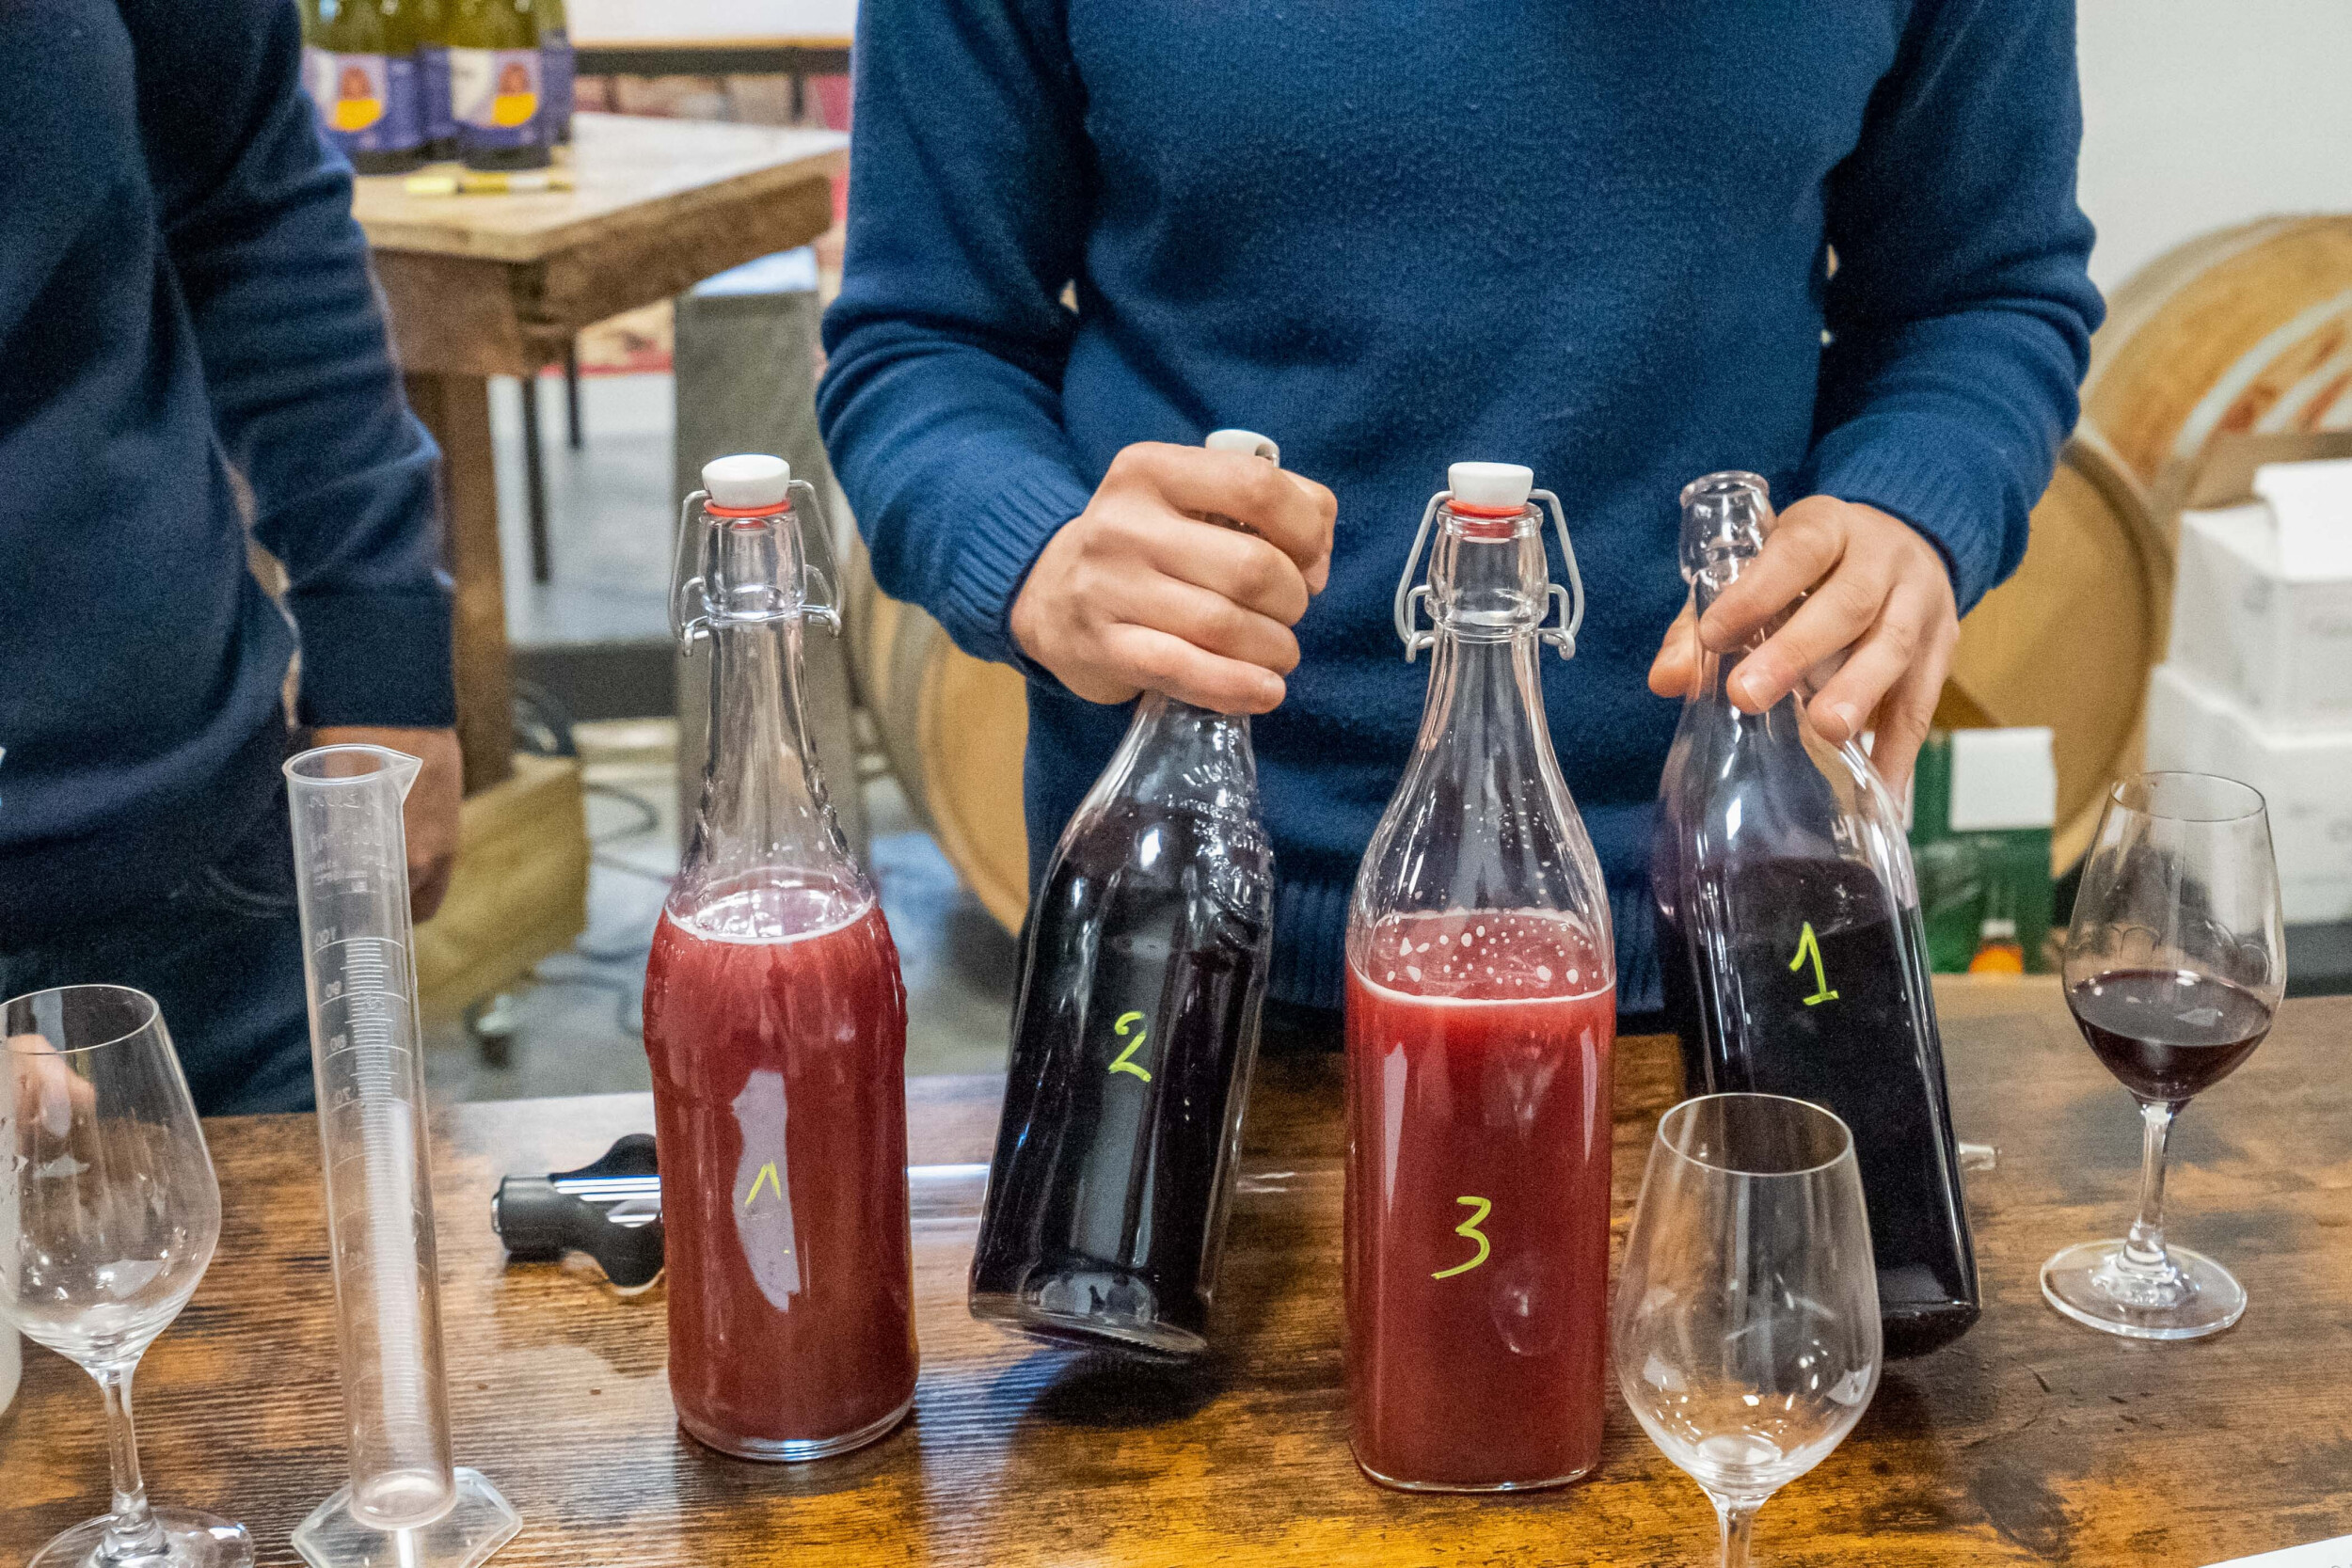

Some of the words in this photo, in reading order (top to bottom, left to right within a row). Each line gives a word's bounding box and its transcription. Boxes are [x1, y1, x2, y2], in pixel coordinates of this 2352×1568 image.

[1788, 921, 1839, 1006] 1
[1108, 1011, 1152, 1083] 2
[1430, 1196, 1491, 1279] 3
